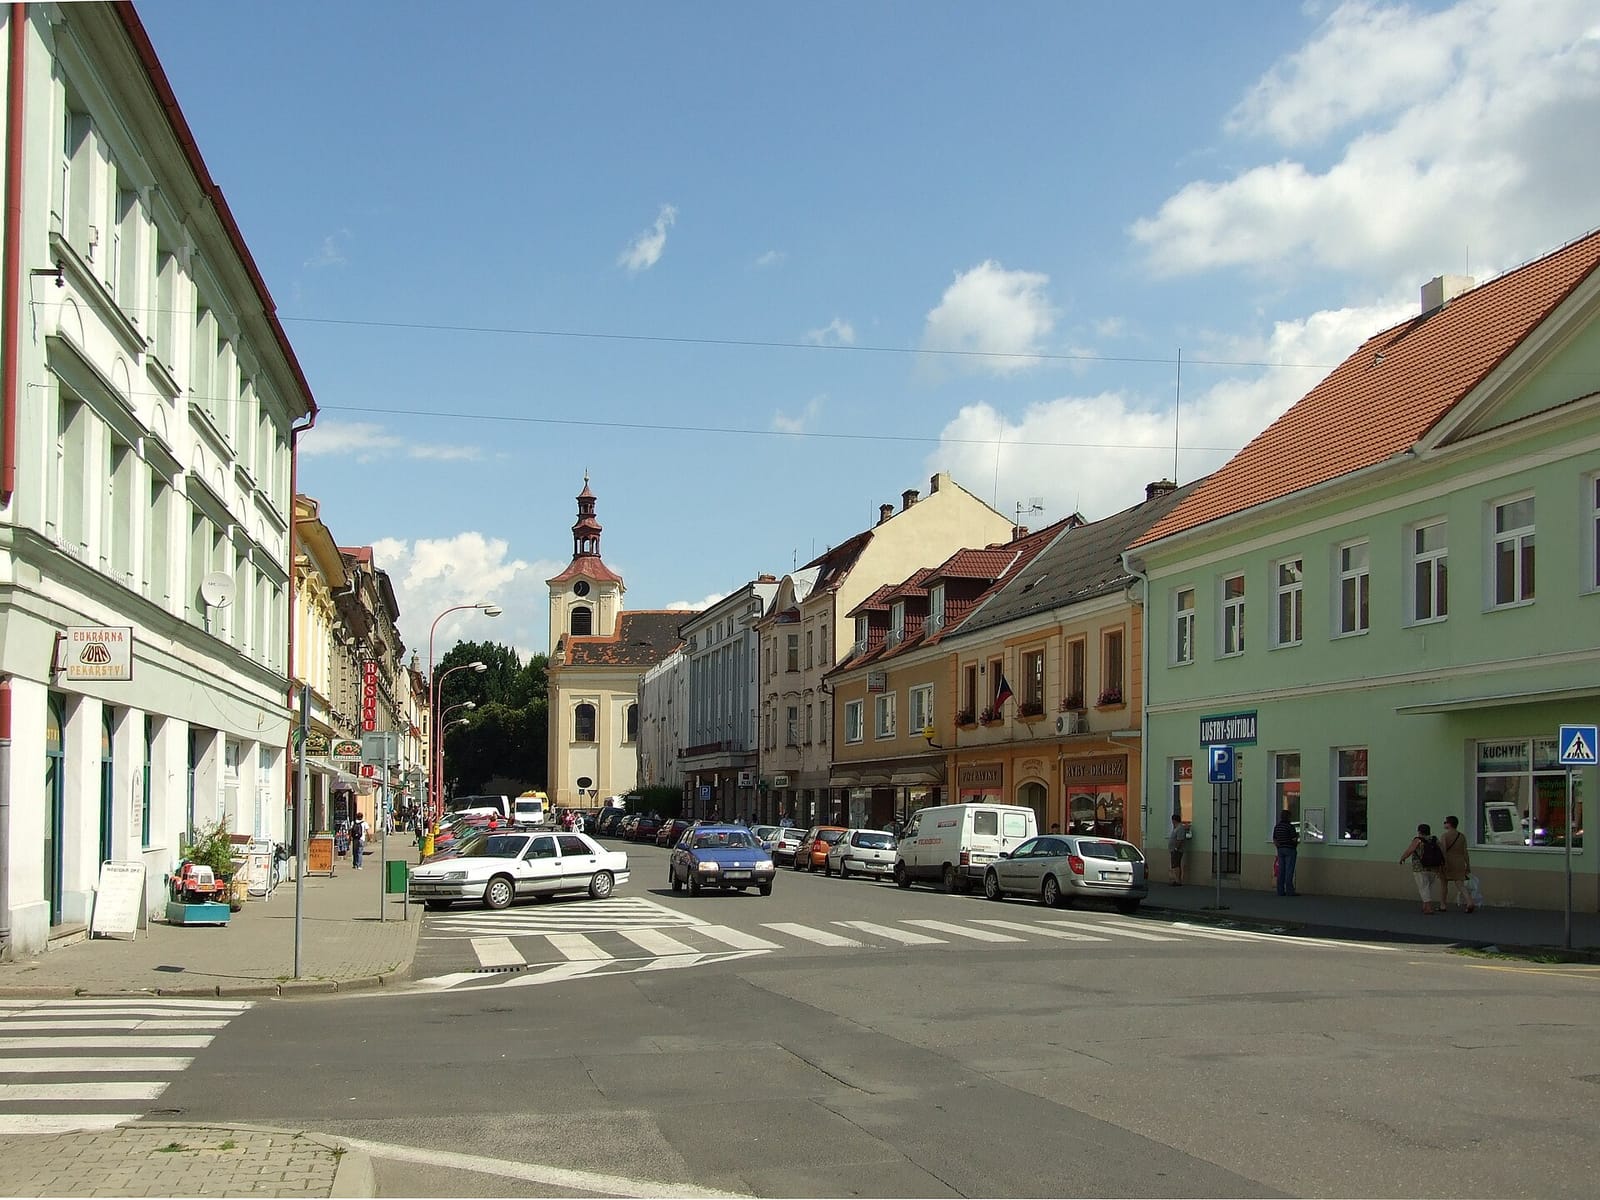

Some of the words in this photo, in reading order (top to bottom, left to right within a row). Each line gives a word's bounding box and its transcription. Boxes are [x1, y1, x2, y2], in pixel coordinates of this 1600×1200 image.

[364, 661, 376, 776] RESTAUT
[1214, 750, 1228, 771] P
[702, 787, 708, 796] P
